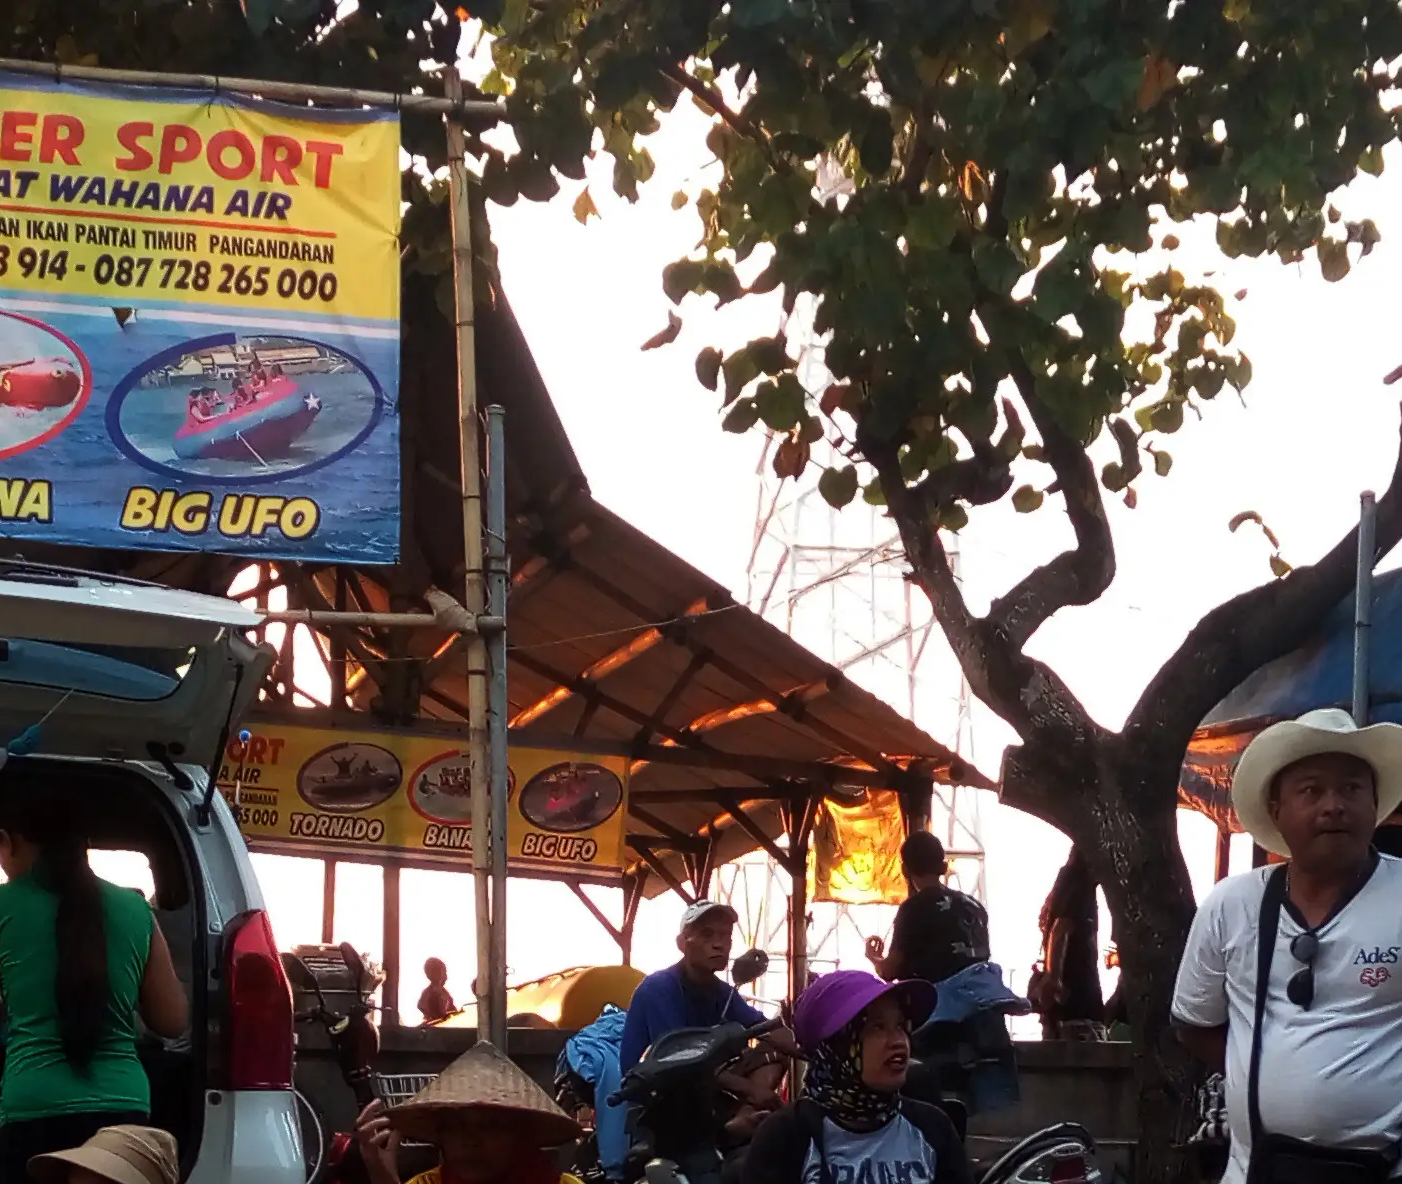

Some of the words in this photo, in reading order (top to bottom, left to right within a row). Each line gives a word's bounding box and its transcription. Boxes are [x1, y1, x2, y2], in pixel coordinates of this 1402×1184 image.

[117, 121, 343, 188] SPORT
[50, 174, 214, 215] WAHANA
[224, 188, 292, 220] AIR
[26, 219, 68, 242] IKAN
[75, 224, 136, 249] PANTAI
[144, 230, 197, 252] TIMUR
[209, 235, 335, 264] PANGANDARAN
[19, 249, 69, 280] 914
[93, 253, 154, 288] 087
[159, 257, 211, 292] 728
[220, 264, 270, 296] 265
[277, 270, 338, 302] 000
[120, 485, 212, 535] BIG
[218, 492, 321, 541] UFO
[232, 768, 261, 784] AIR
[253, 808, 278, 826] 000
[289, 812, 384, 842] TORNADO
[521, 834, 558, 858] BIG
[557, 838, 597, 862] UFO
[1352, 946, 1402, 965] AdeS
